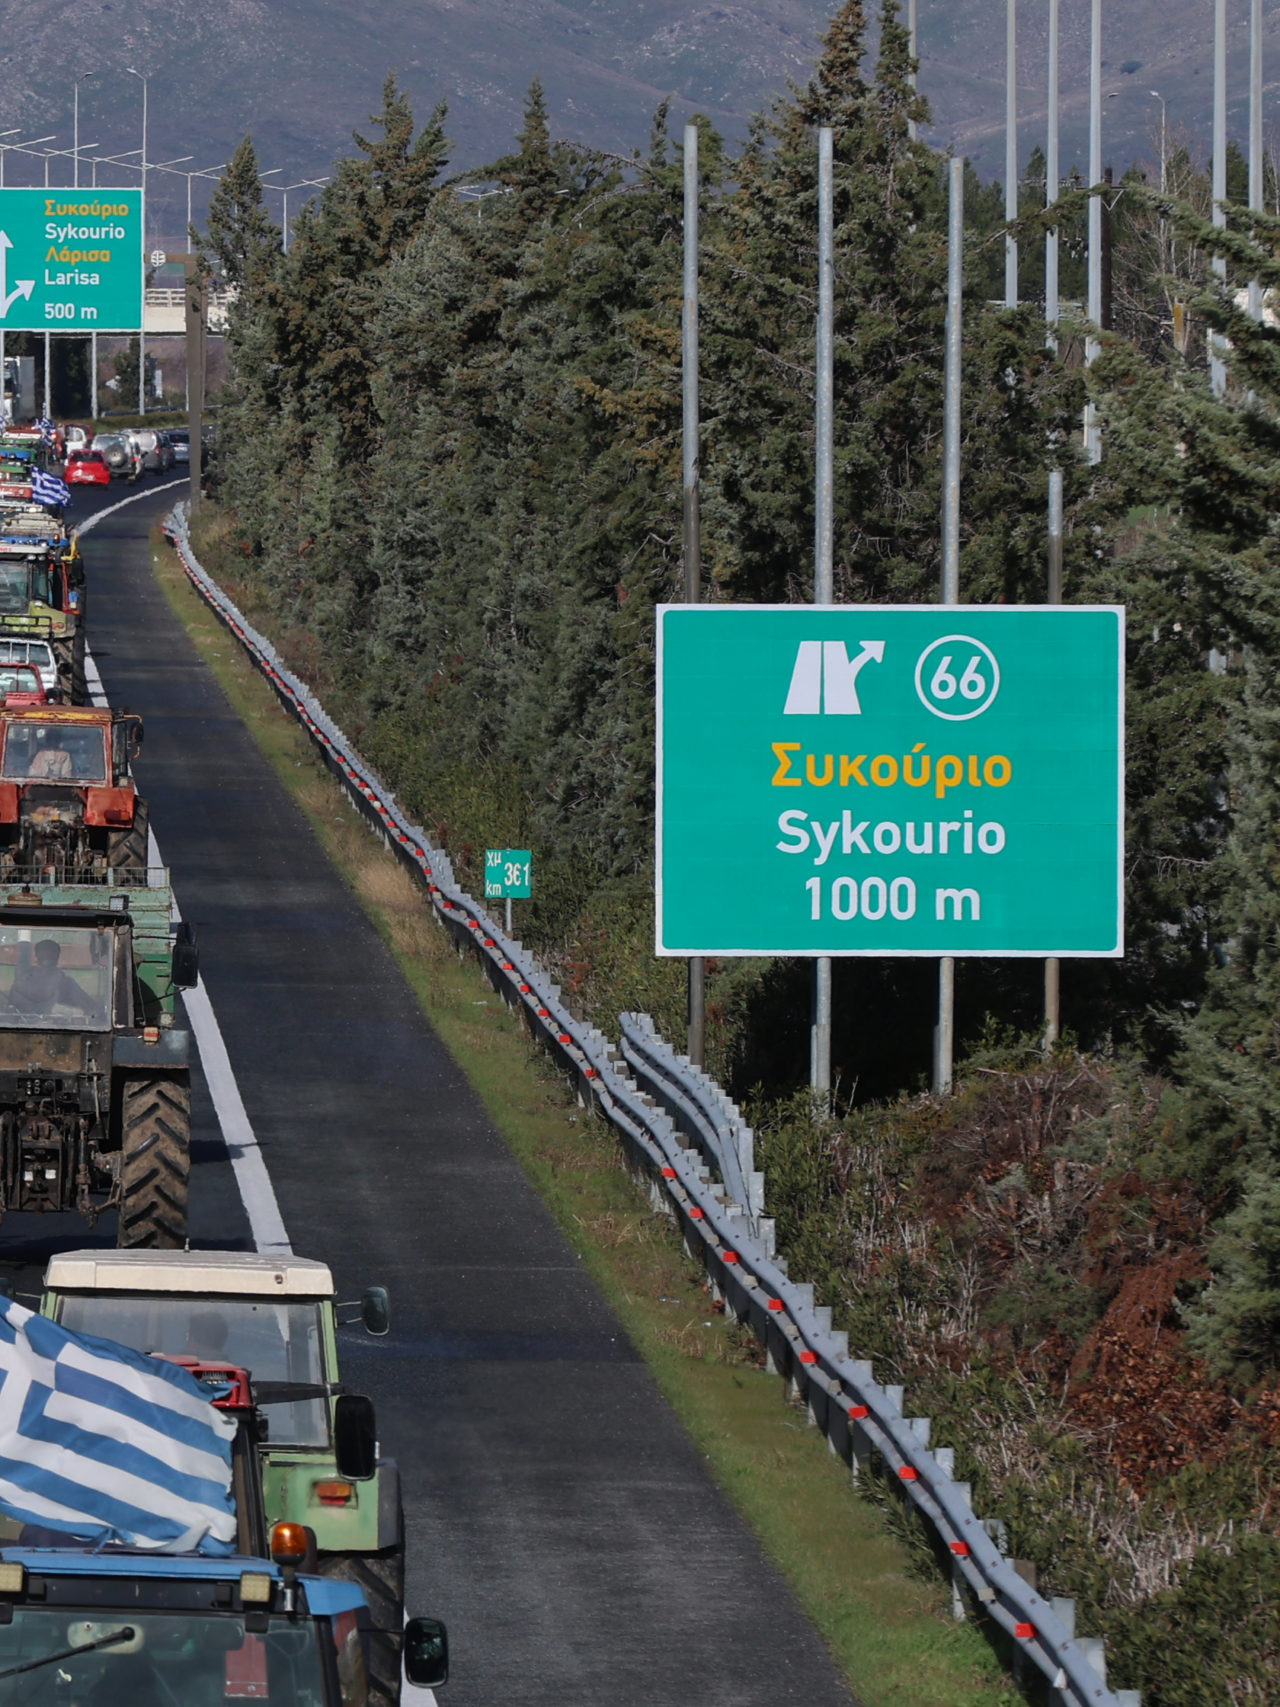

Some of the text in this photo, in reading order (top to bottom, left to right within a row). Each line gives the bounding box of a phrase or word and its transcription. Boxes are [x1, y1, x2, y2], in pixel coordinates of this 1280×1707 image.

[44, 199, 129, 219] Συκούριο
[45, 223, 125, 243] Sykourio
[45, 247, 111, 266] Λάρισα
[44, 269, 100, 286] Larisa
[44, 303, 98, 320] 500 m
[930, 655, 986, 700] 66
[771, 742, 1012, 799] Συκούριο
[775, 809, 1006, 866] Sykourio
[504, 862, 530, 886] 361
[486, 879, 502, 896] km
[804, 876, 981, 921] 1000 m
